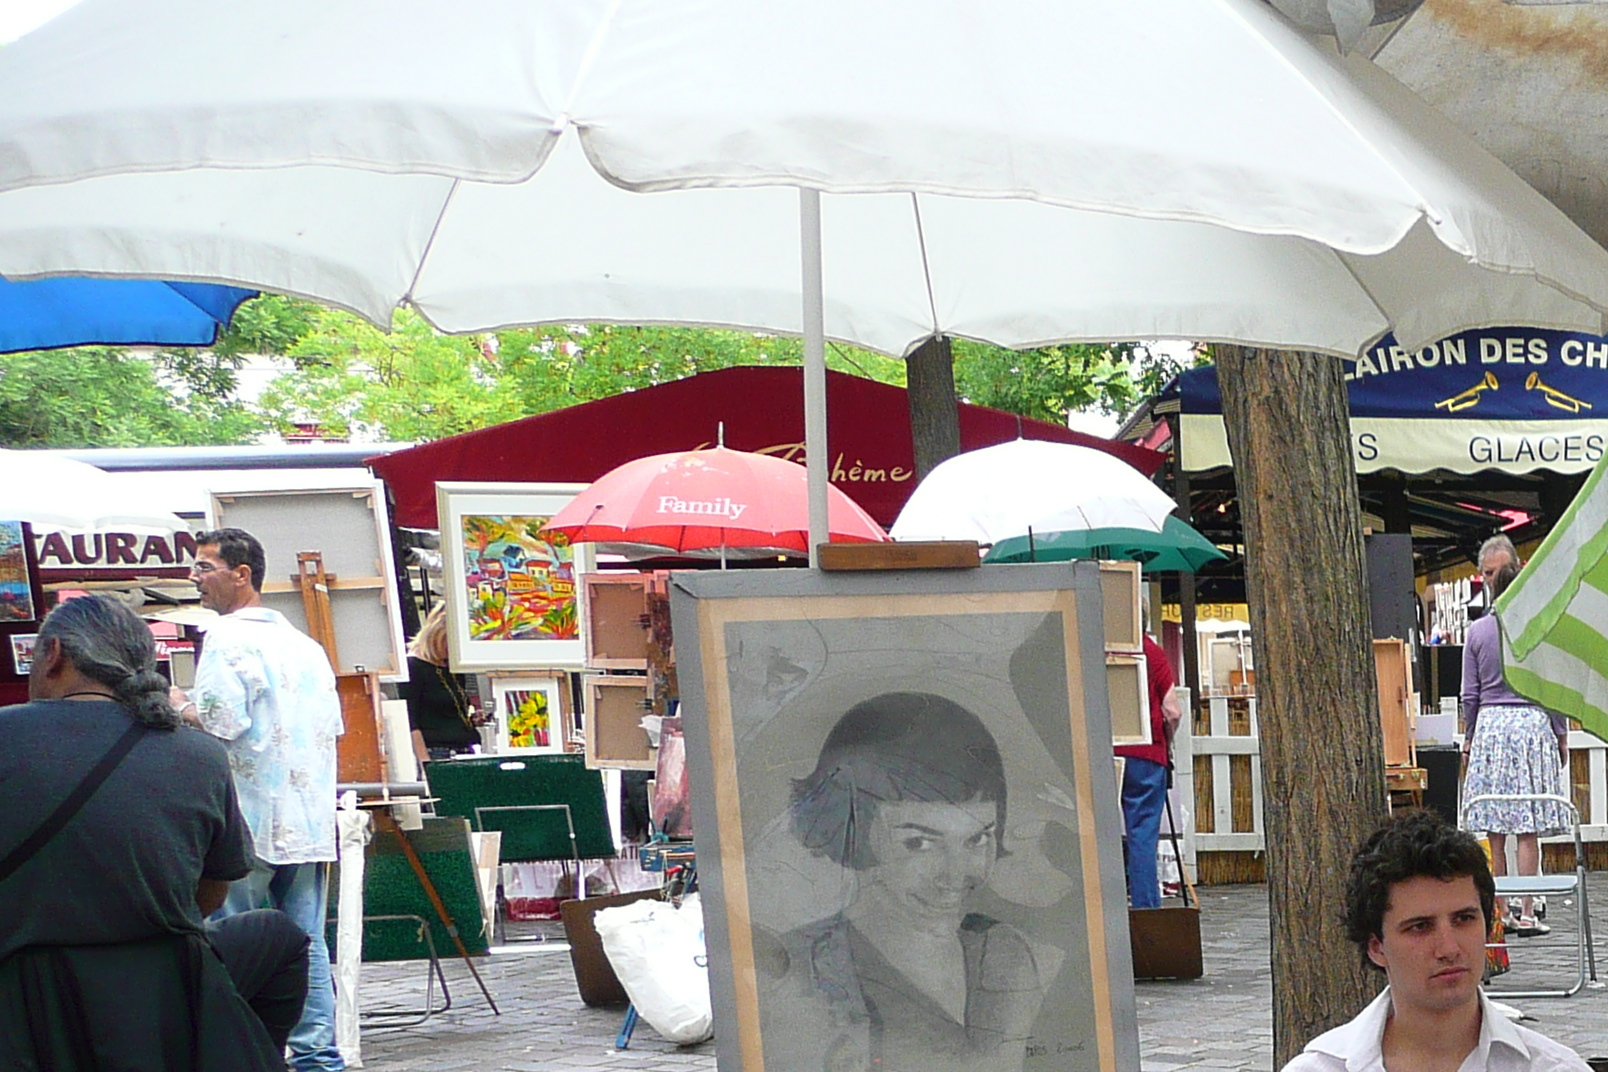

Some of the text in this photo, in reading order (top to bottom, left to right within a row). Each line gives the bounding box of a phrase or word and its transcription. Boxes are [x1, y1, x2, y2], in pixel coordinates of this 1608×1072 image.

[1480, 338, 1548, 364] DES
[1469, 435, 1604, 463] GLACES
[656, 496, 747, 520] Family
